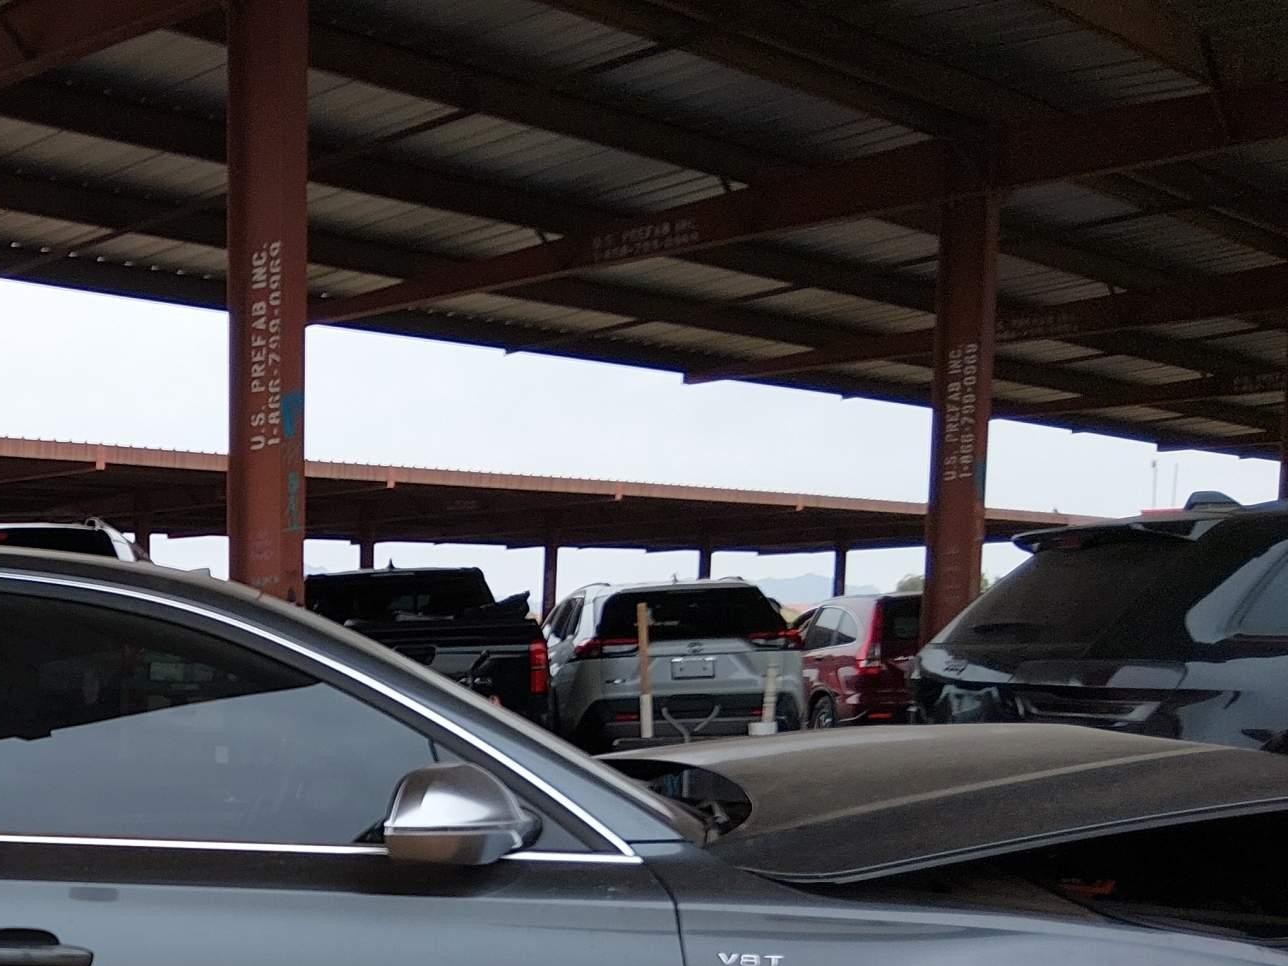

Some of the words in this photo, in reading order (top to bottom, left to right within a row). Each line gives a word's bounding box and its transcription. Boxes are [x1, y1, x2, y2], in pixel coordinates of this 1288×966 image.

[251, 242, 267, 290] INC.
[251, 301, 267, 393] PREFAB
[250, 404, 266, 450] U.S.
[944, 382, 962, 443] PREFAB
